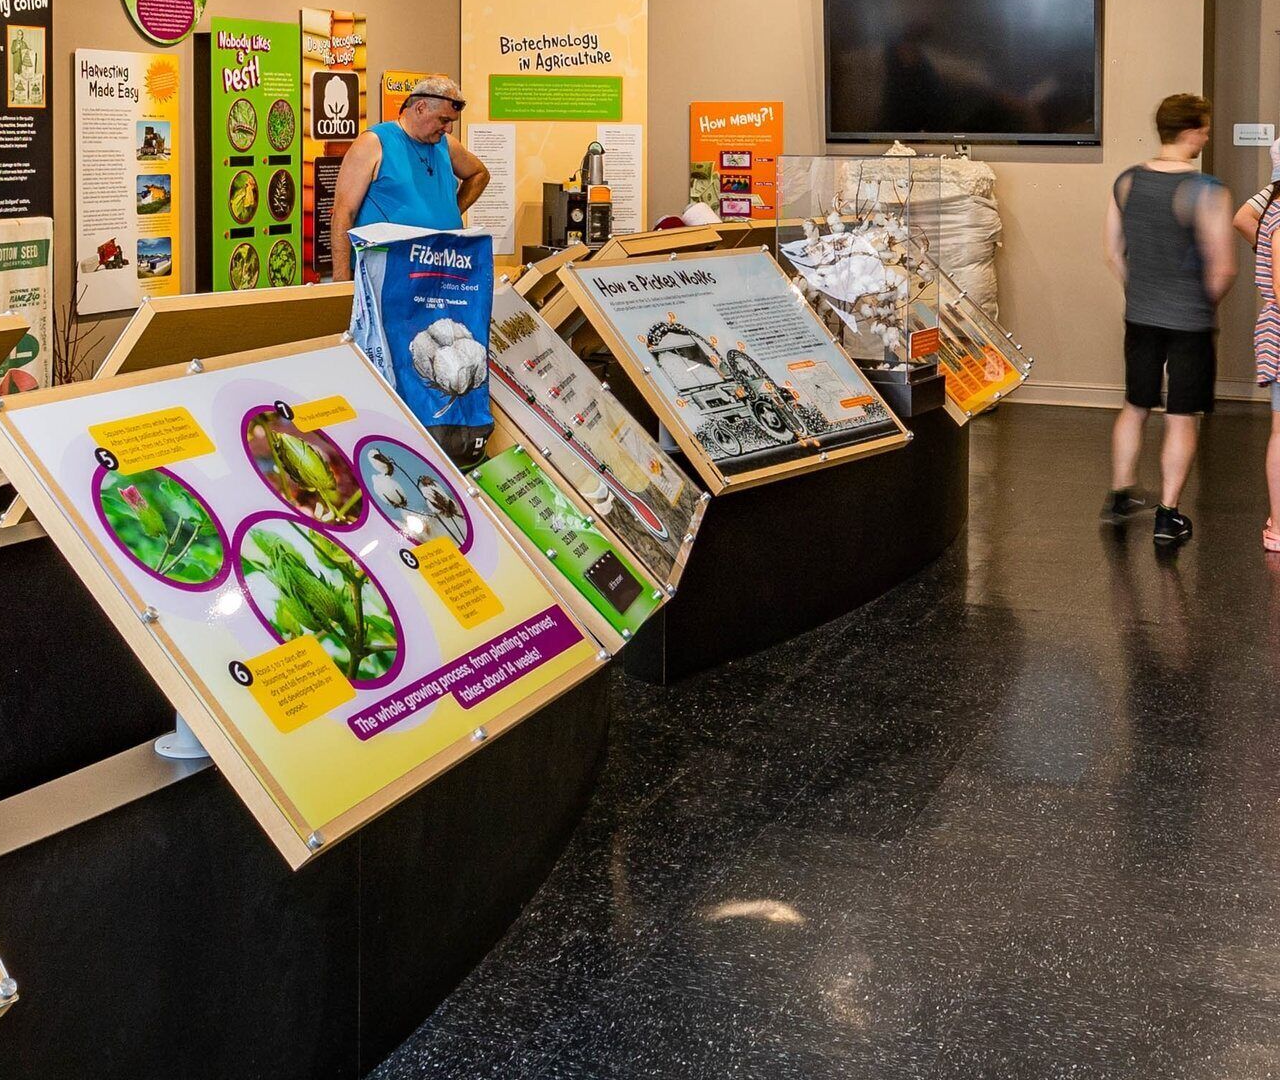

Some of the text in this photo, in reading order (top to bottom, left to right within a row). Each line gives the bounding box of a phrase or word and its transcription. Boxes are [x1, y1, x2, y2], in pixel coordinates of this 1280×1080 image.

[218, 31, 251, 53] Nobody
[307, 37, 318, 51] Do
[319, 37, 331, 53] you
[237, 51, 244, 62] a
[322, 51, 335, 65] this
[89, 81, 138, 103] Made Easy
[318, 119, 354, 134] cotton
[700, 116, 726, 133] How
[21, 245, 38, 258] SEED
[410, 244, 472, 269] FiberMax
[461, 282, 478, 291] Seed
[593, 277, 626, 298] How
[627, 280, 639, 292] a
[277, 403, 289, 417] 7
[101, 451, 114, 468] 5
[403, 551, 416, 566] 8
[234, 664, 248, 682] 6
[355, 615, 557, 734] The whole growing process, from planting to harvest,
[460, 647, 542, 702] takes about 14 weeks!
